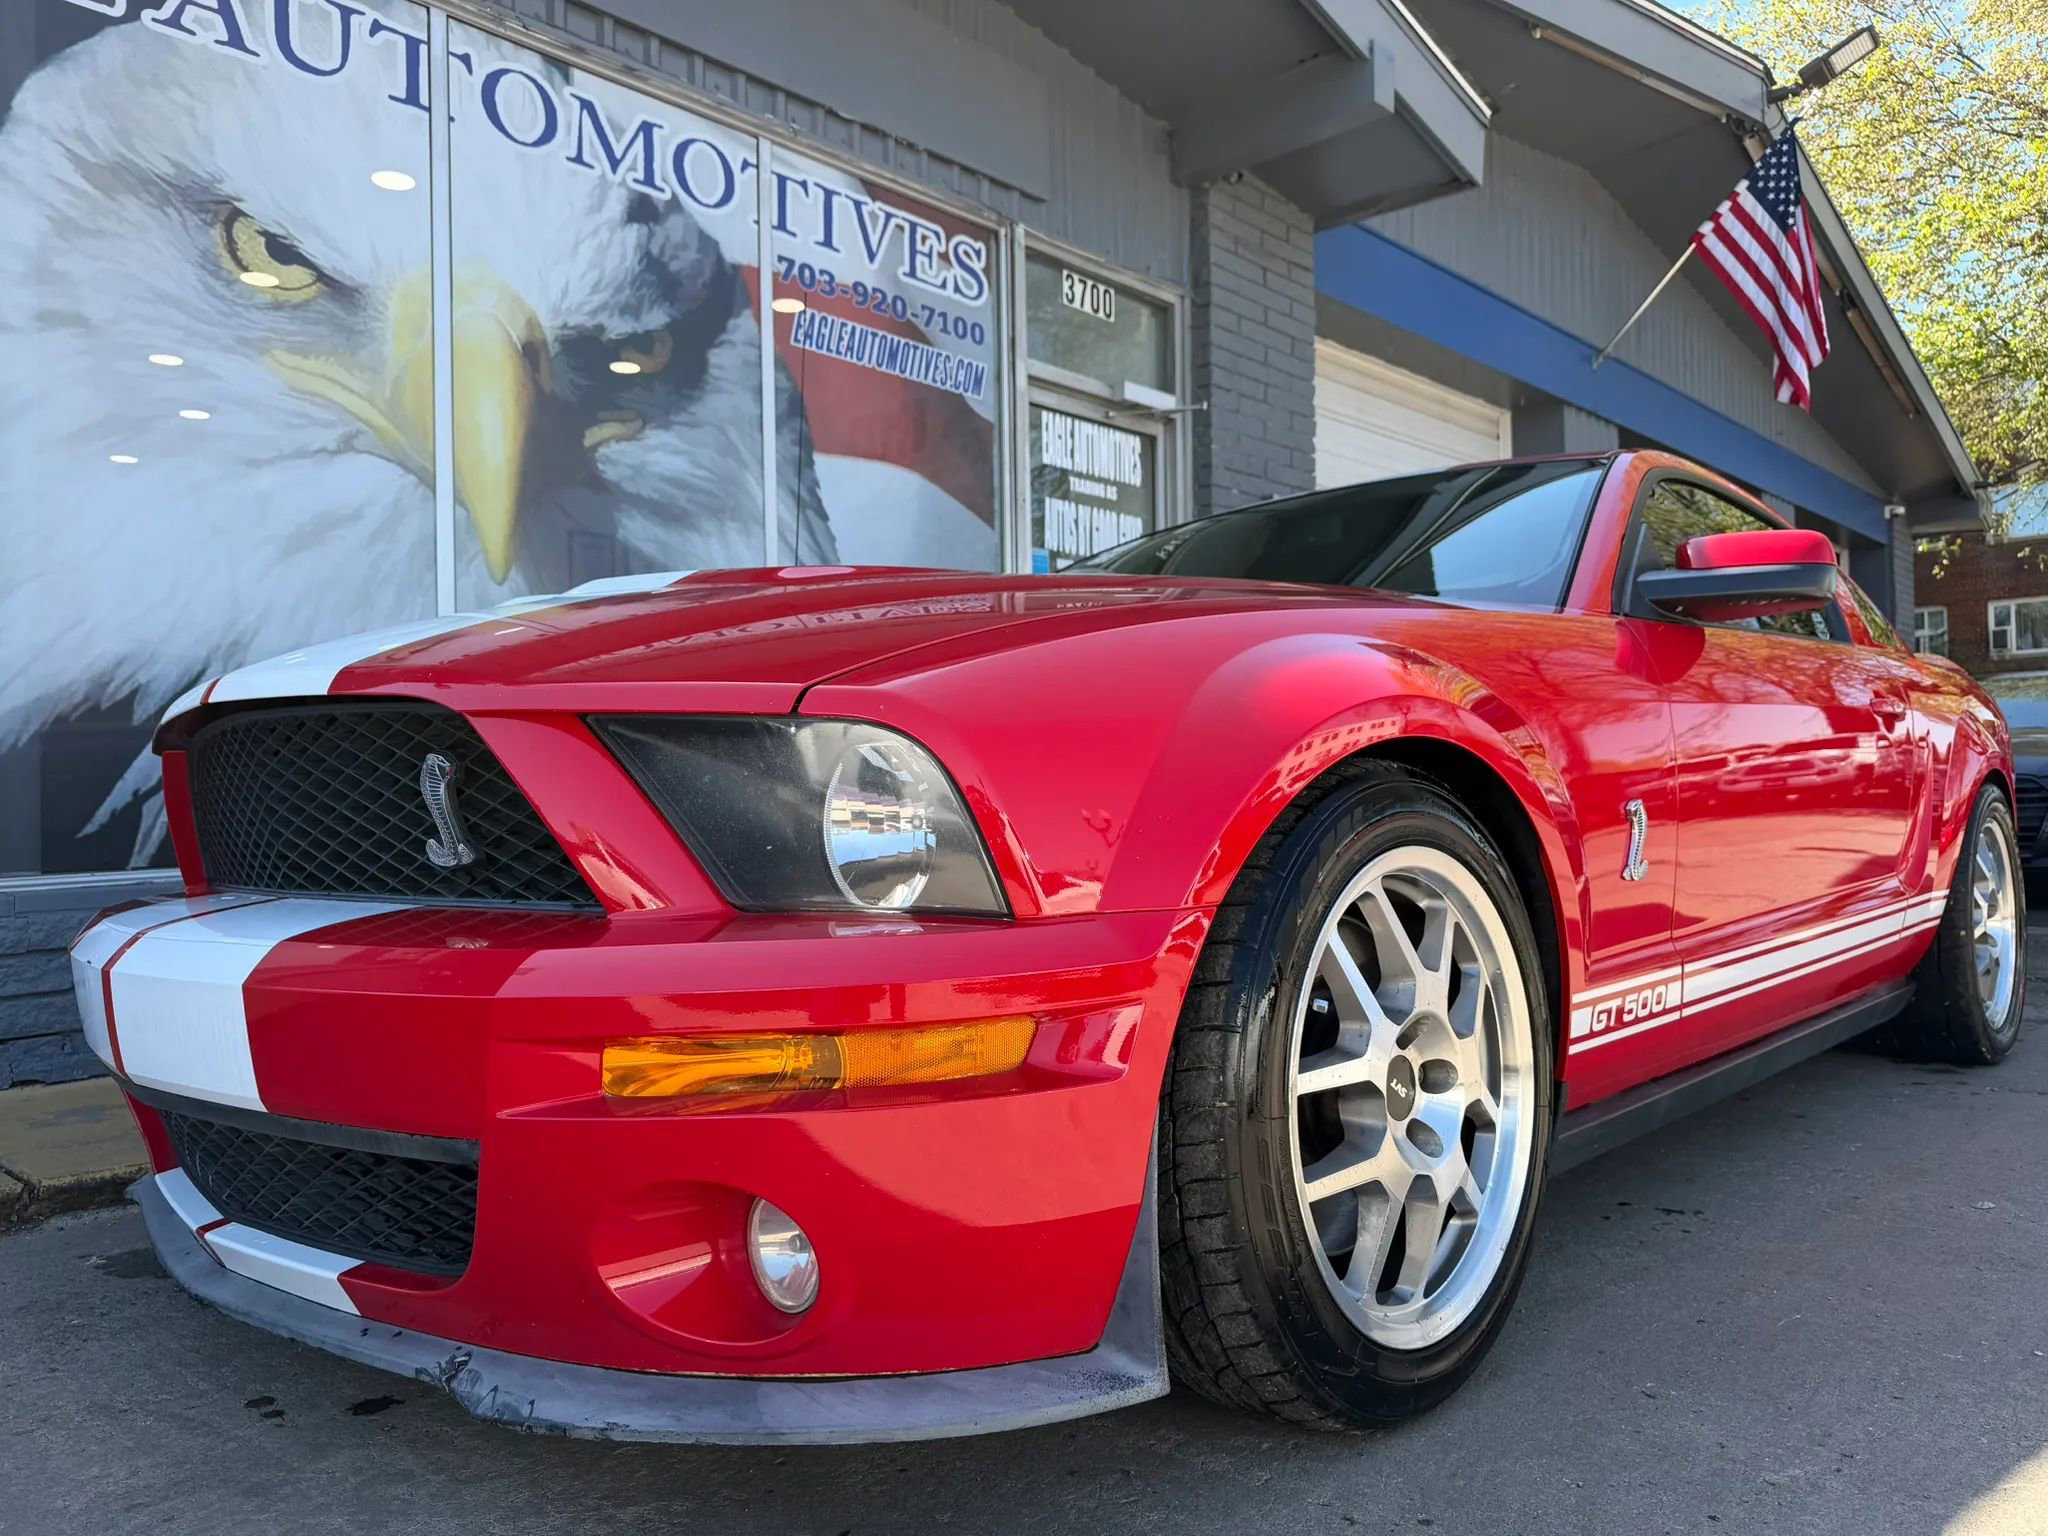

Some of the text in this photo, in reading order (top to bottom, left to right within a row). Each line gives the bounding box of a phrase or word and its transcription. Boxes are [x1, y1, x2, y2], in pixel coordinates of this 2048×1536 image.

[777, 255, 985, 346] 703-920-7100
[1065, 273, 1112, 320] 3700
[791, 309, 986, 398] EAGLEAUTOMOTIVES.COM
[1041, 410, 1143, 488] EAGLE AUTOMOTIVES
[1623, 984, 1667, 1022] 500
[1389, 1078, 1408, 1098] SVT
